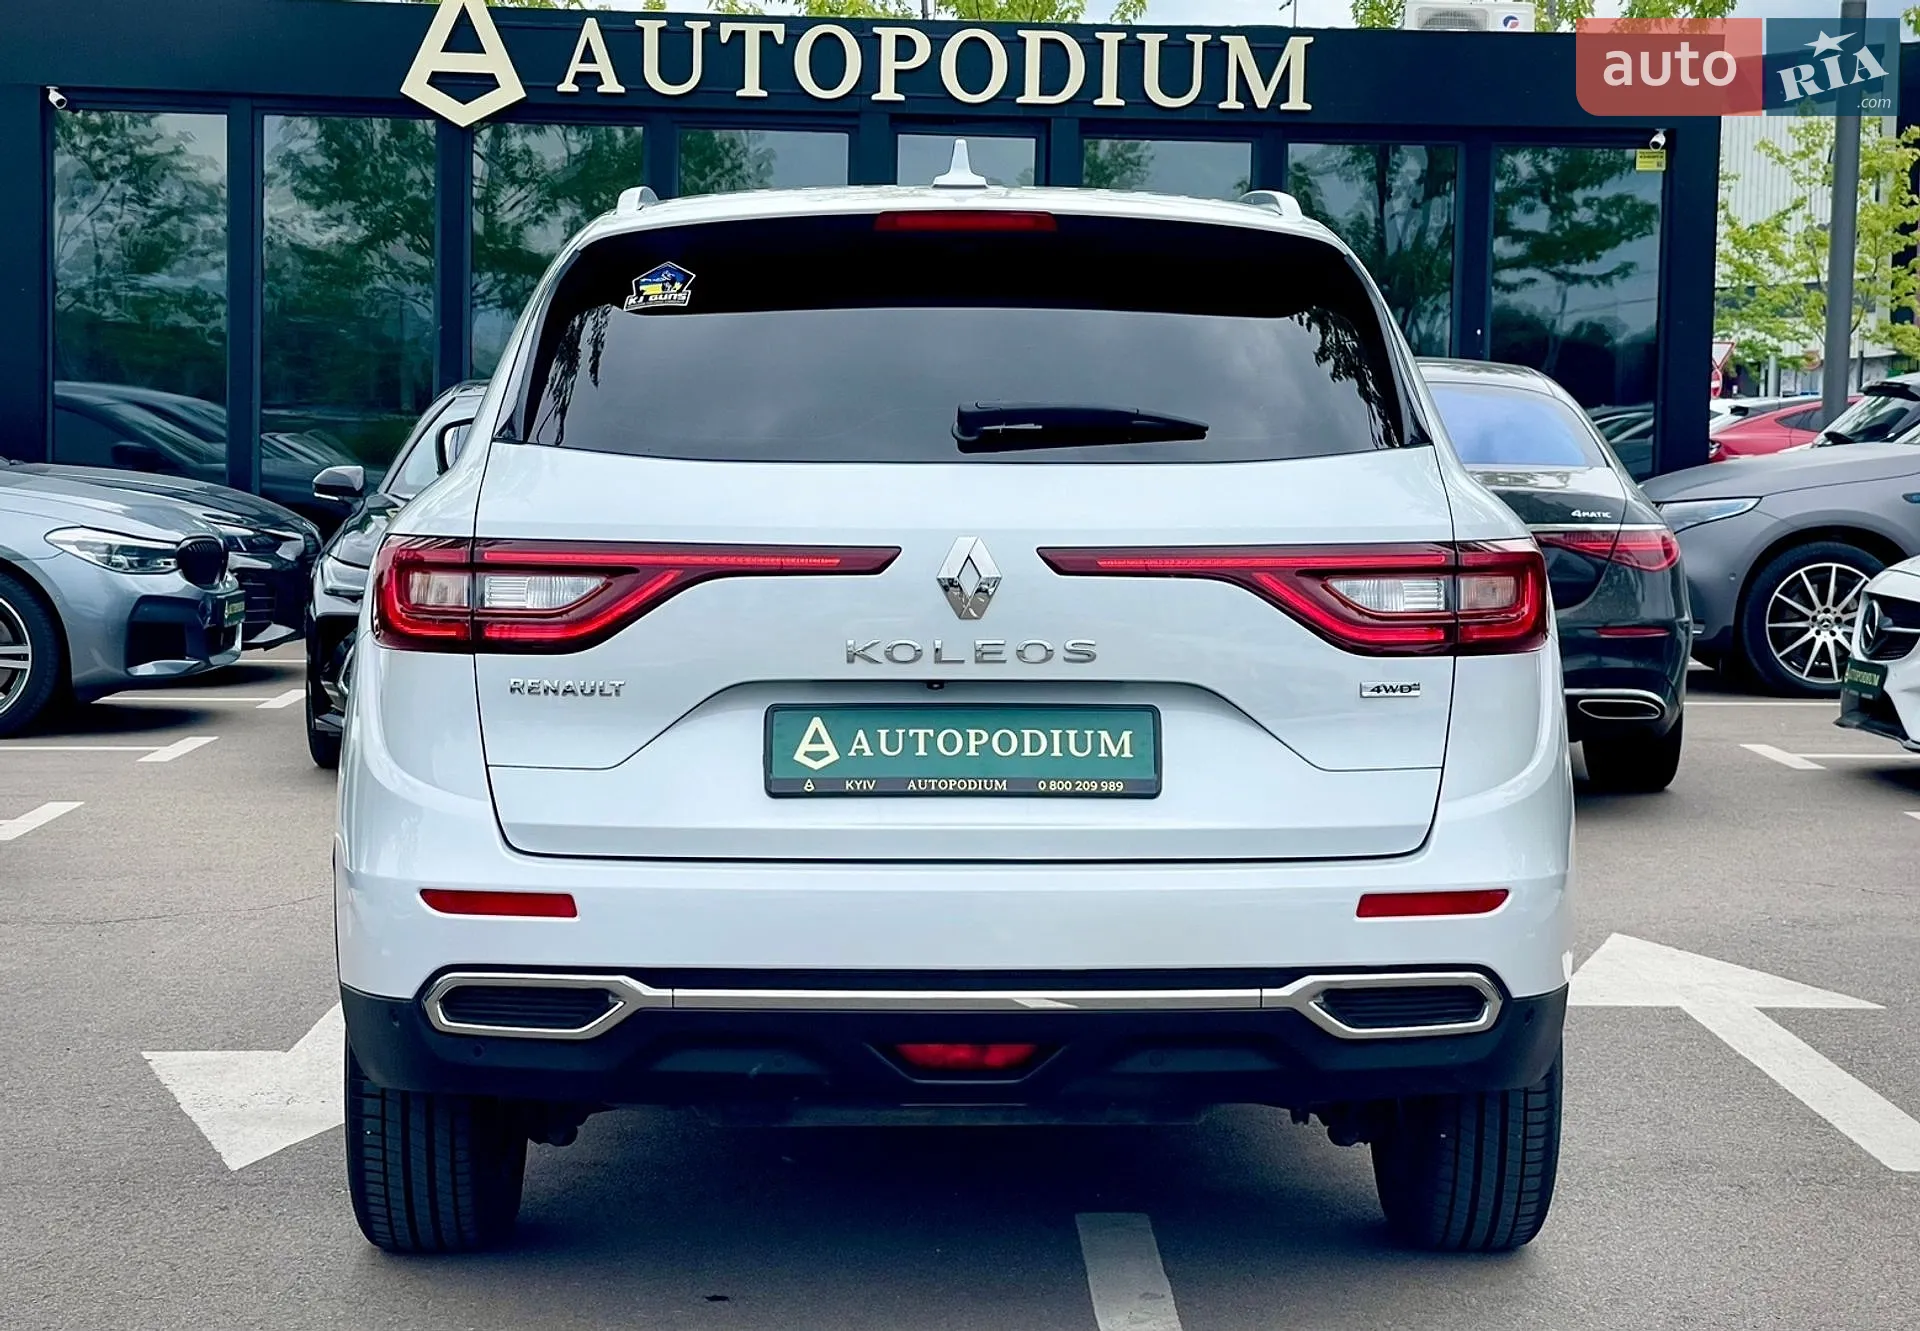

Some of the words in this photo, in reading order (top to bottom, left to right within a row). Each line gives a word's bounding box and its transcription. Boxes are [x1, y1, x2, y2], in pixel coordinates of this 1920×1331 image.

[556, 17, 1314, 111] AUTOPODIUM
[846, 639, 1097, 664] KOLEOS
[510, 678, 625, 697] RENAULT
[848, 728, 1134, 758] AUTOPODIUM
[845, 780, 877, 790] KYIV
[908, 779, 1008, 791] AUTOPODIUM
[1038, 780, 1047, 791] 0
[1049, 780, 1073, 791] 800
[1075, 780, 1098, 791] 209
[1101, 781, 1124, 791] 989
